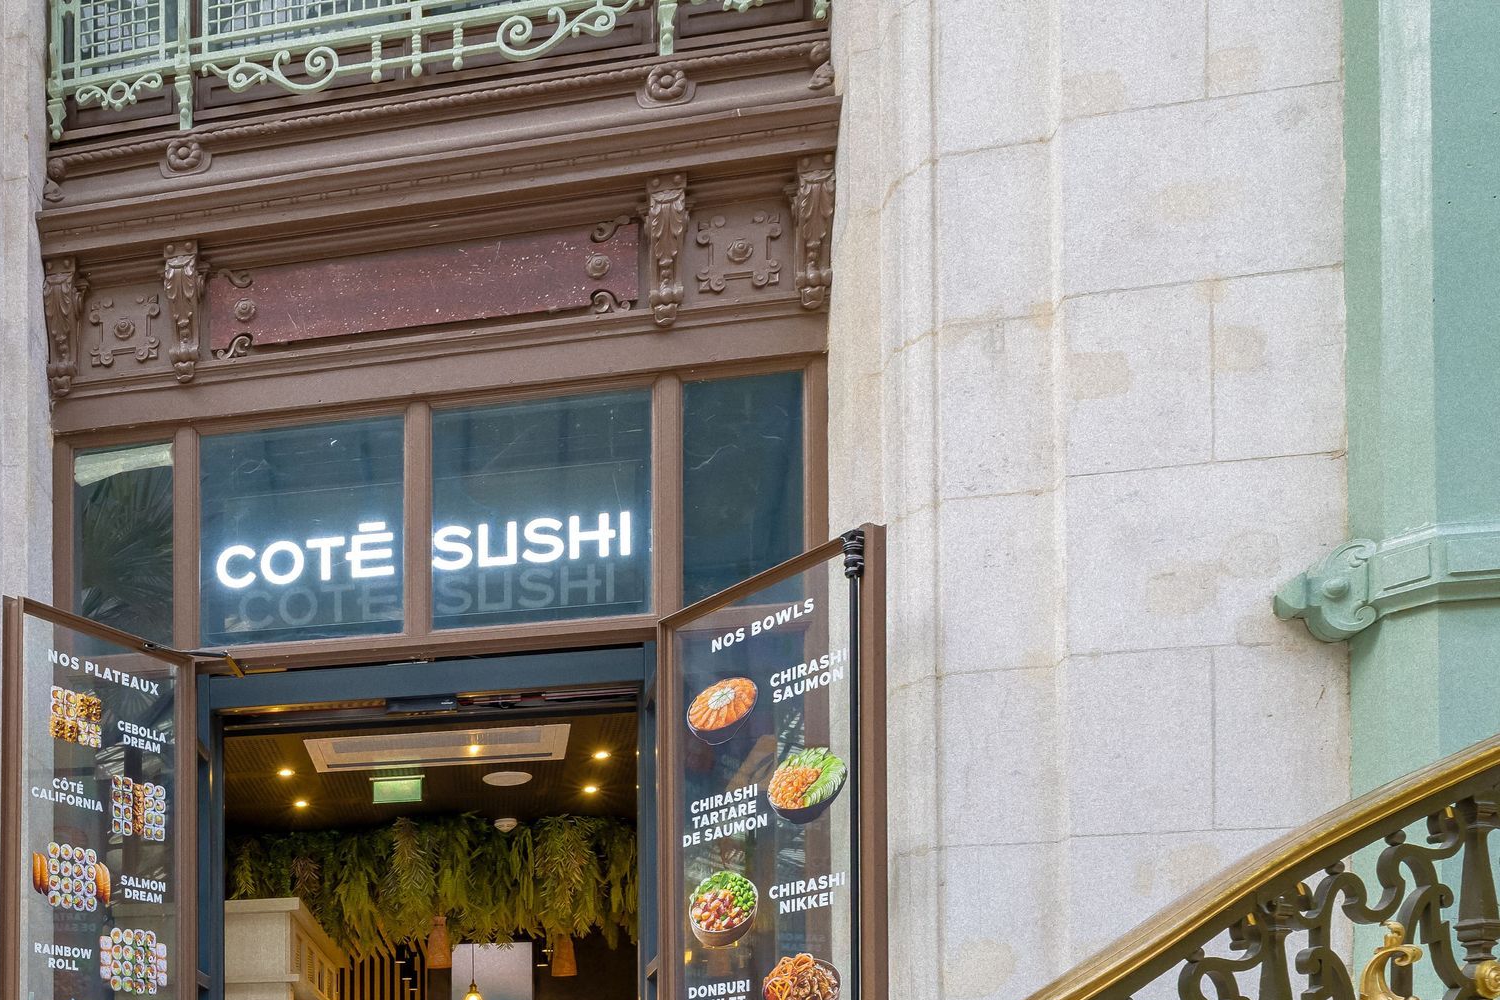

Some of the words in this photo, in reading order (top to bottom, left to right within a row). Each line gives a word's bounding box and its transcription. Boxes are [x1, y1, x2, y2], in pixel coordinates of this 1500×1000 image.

[432, 511, 631, 571] SUSHI
[711, 628, 745, 653] NOS
[752, 597, 815, 637] BOWLS
[47, 649, 80, 671] NOS
[84, 660, 160, 696] PLATEAUX
[770, 647, 849, 688] CHIRASHI
[772, 666, 844, 704] SAUMON
[117, 720, 167, 744] CEBOLLA
[123, 734, 161, 754] DREAM
[52, 777, 84, 794] CÔTÉ
[31, 786, 104, 812] CALIFORNIA
[690, 783, 758, 815] CHIRASHI
[692, 800, 757, 830] TARTARE
[683, 832, 701, 848] DE
[704, 813, 768, 842] SAUMON
[120, 875, 166, 893] SALMON
[124, 887, 163, 903] DREAM
[769, 871, 846, 900] CHIRASHI
[779, 891, 834, 915] NIKKEI
[34, 942, 93, 959] RAINBOW
[48, 957, 79, 971] ROLL
[688, 979, 751, 1000] DONBURI
